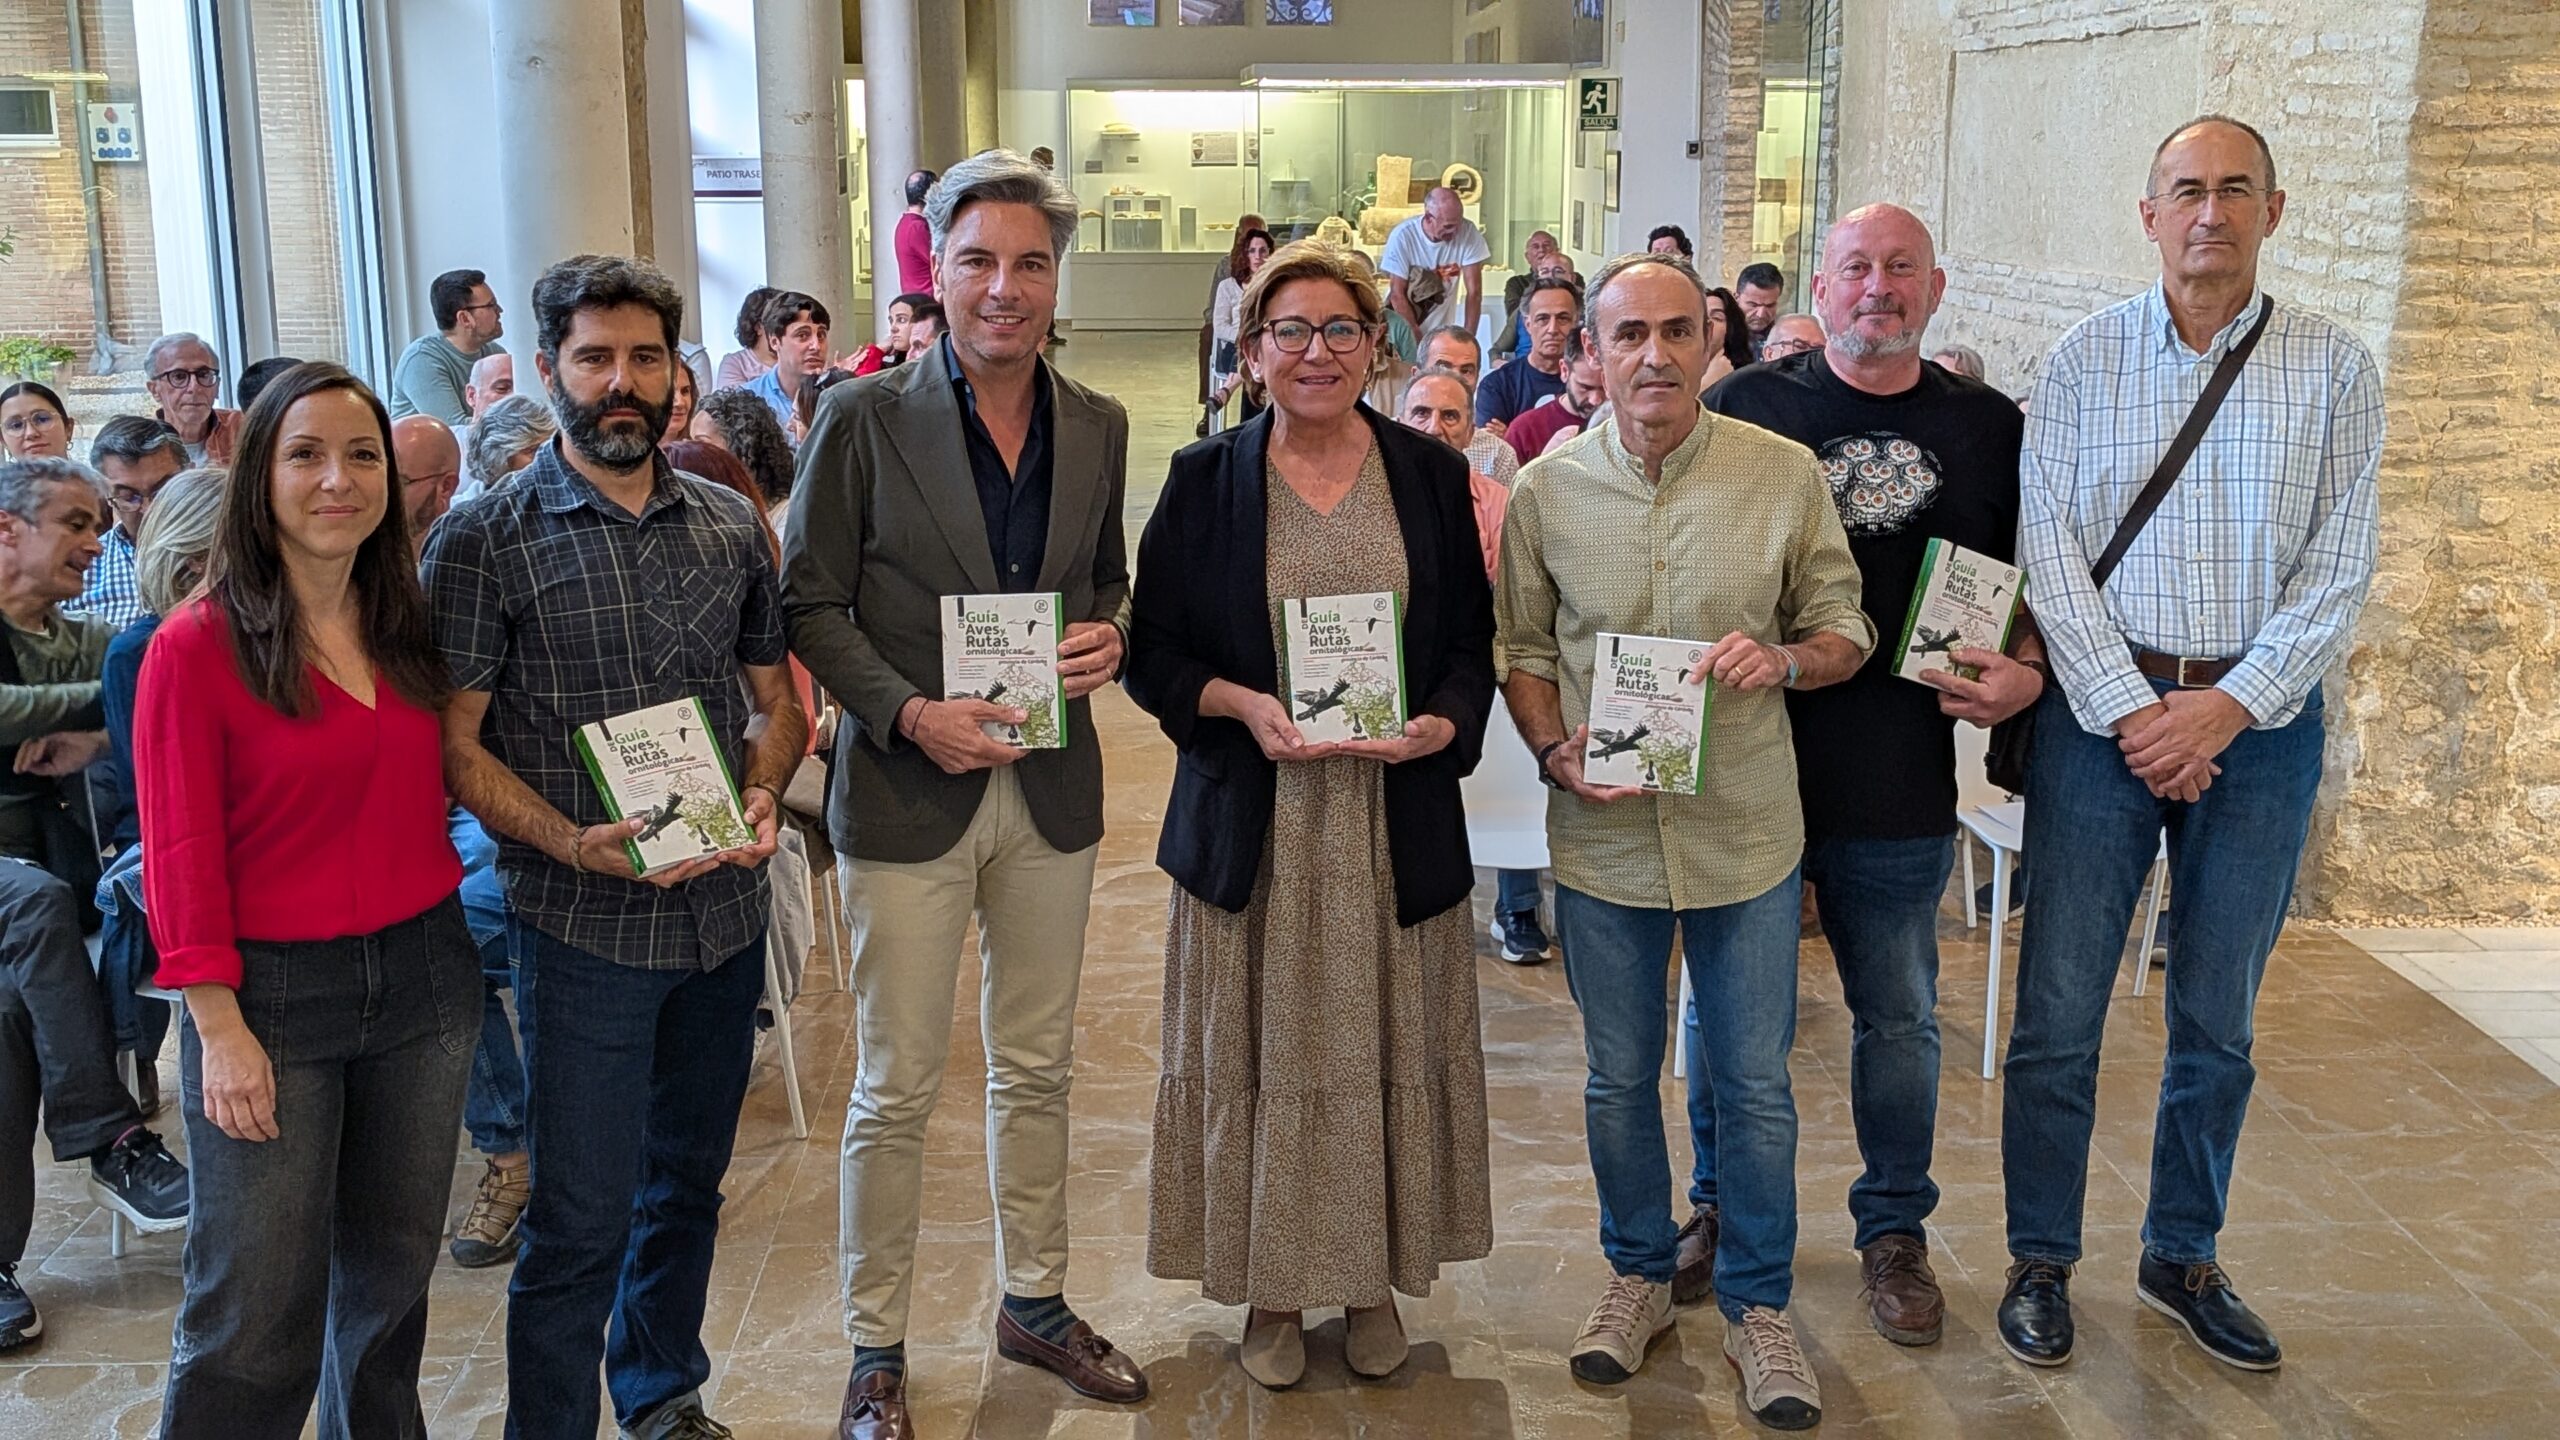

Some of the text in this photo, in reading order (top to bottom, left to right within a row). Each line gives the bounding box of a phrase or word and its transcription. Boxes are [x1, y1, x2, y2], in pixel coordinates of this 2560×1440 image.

[1584, 118, 1614, 126] SALIDA
[706, 170, 761, 178] PATIO TRASE
[1952, 560, 1977, 577] Guía
[1948, 571, 1974, 588] Aves
[1945, 580, 1978, 601] Rutas
[966, 610, 999, 623] Guía
[1309, 610, 1340, 623] Guía
[966, 624, 1000, 635] Aves
[1309, 624, 1342, 635] Aves
[966, 635, 1009, 648] Rutas
[1310, 634, 1351, 647] Rutas
[1619, 653, 1652, 667] Guía
[1617, 665, 1650, 679] Aves
[1616, 676, 1659, 692] Rutas
[614, 727, 649, 744] Guía
[620, 739, 654, 756] Aves
[623, 746, 669, 767] Rutas
